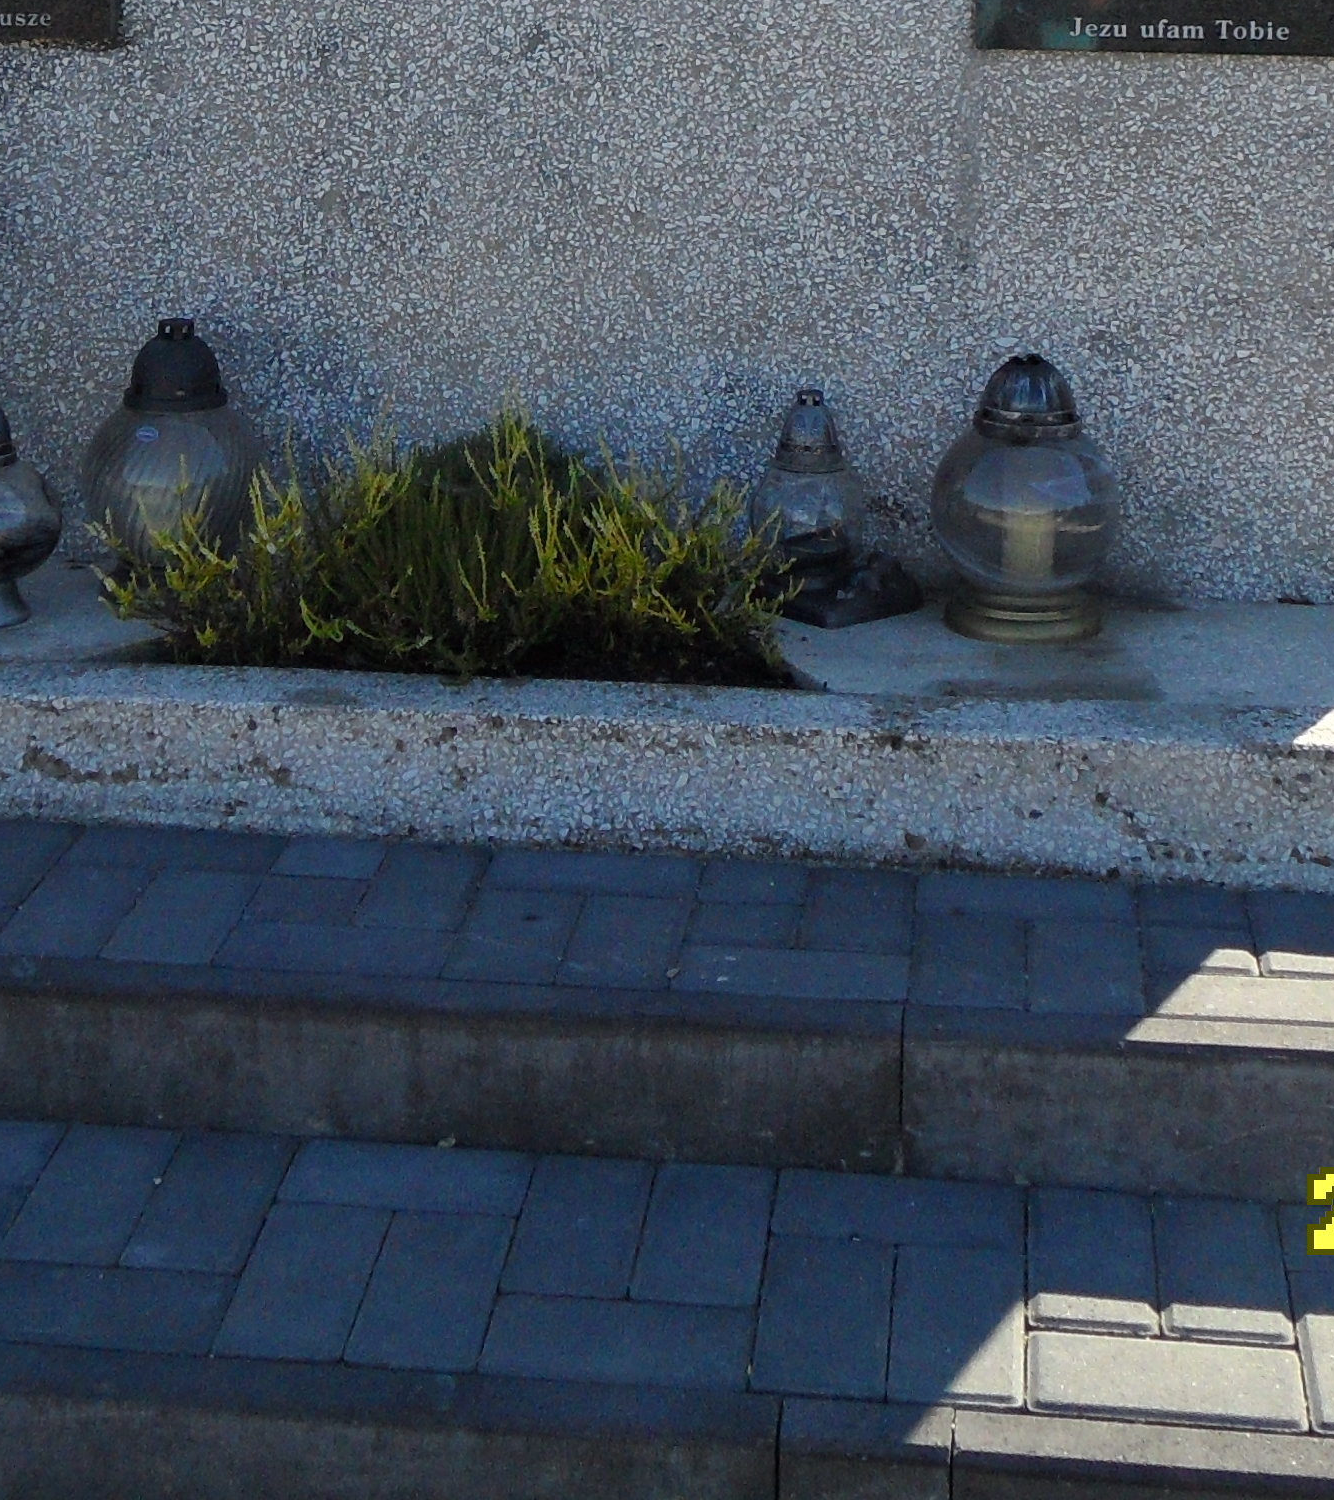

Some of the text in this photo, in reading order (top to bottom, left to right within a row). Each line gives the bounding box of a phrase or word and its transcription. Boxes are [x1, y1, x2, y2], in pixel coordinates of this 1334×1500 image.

[1069, 16, 1291, 42] Jezu ufam Tobie
